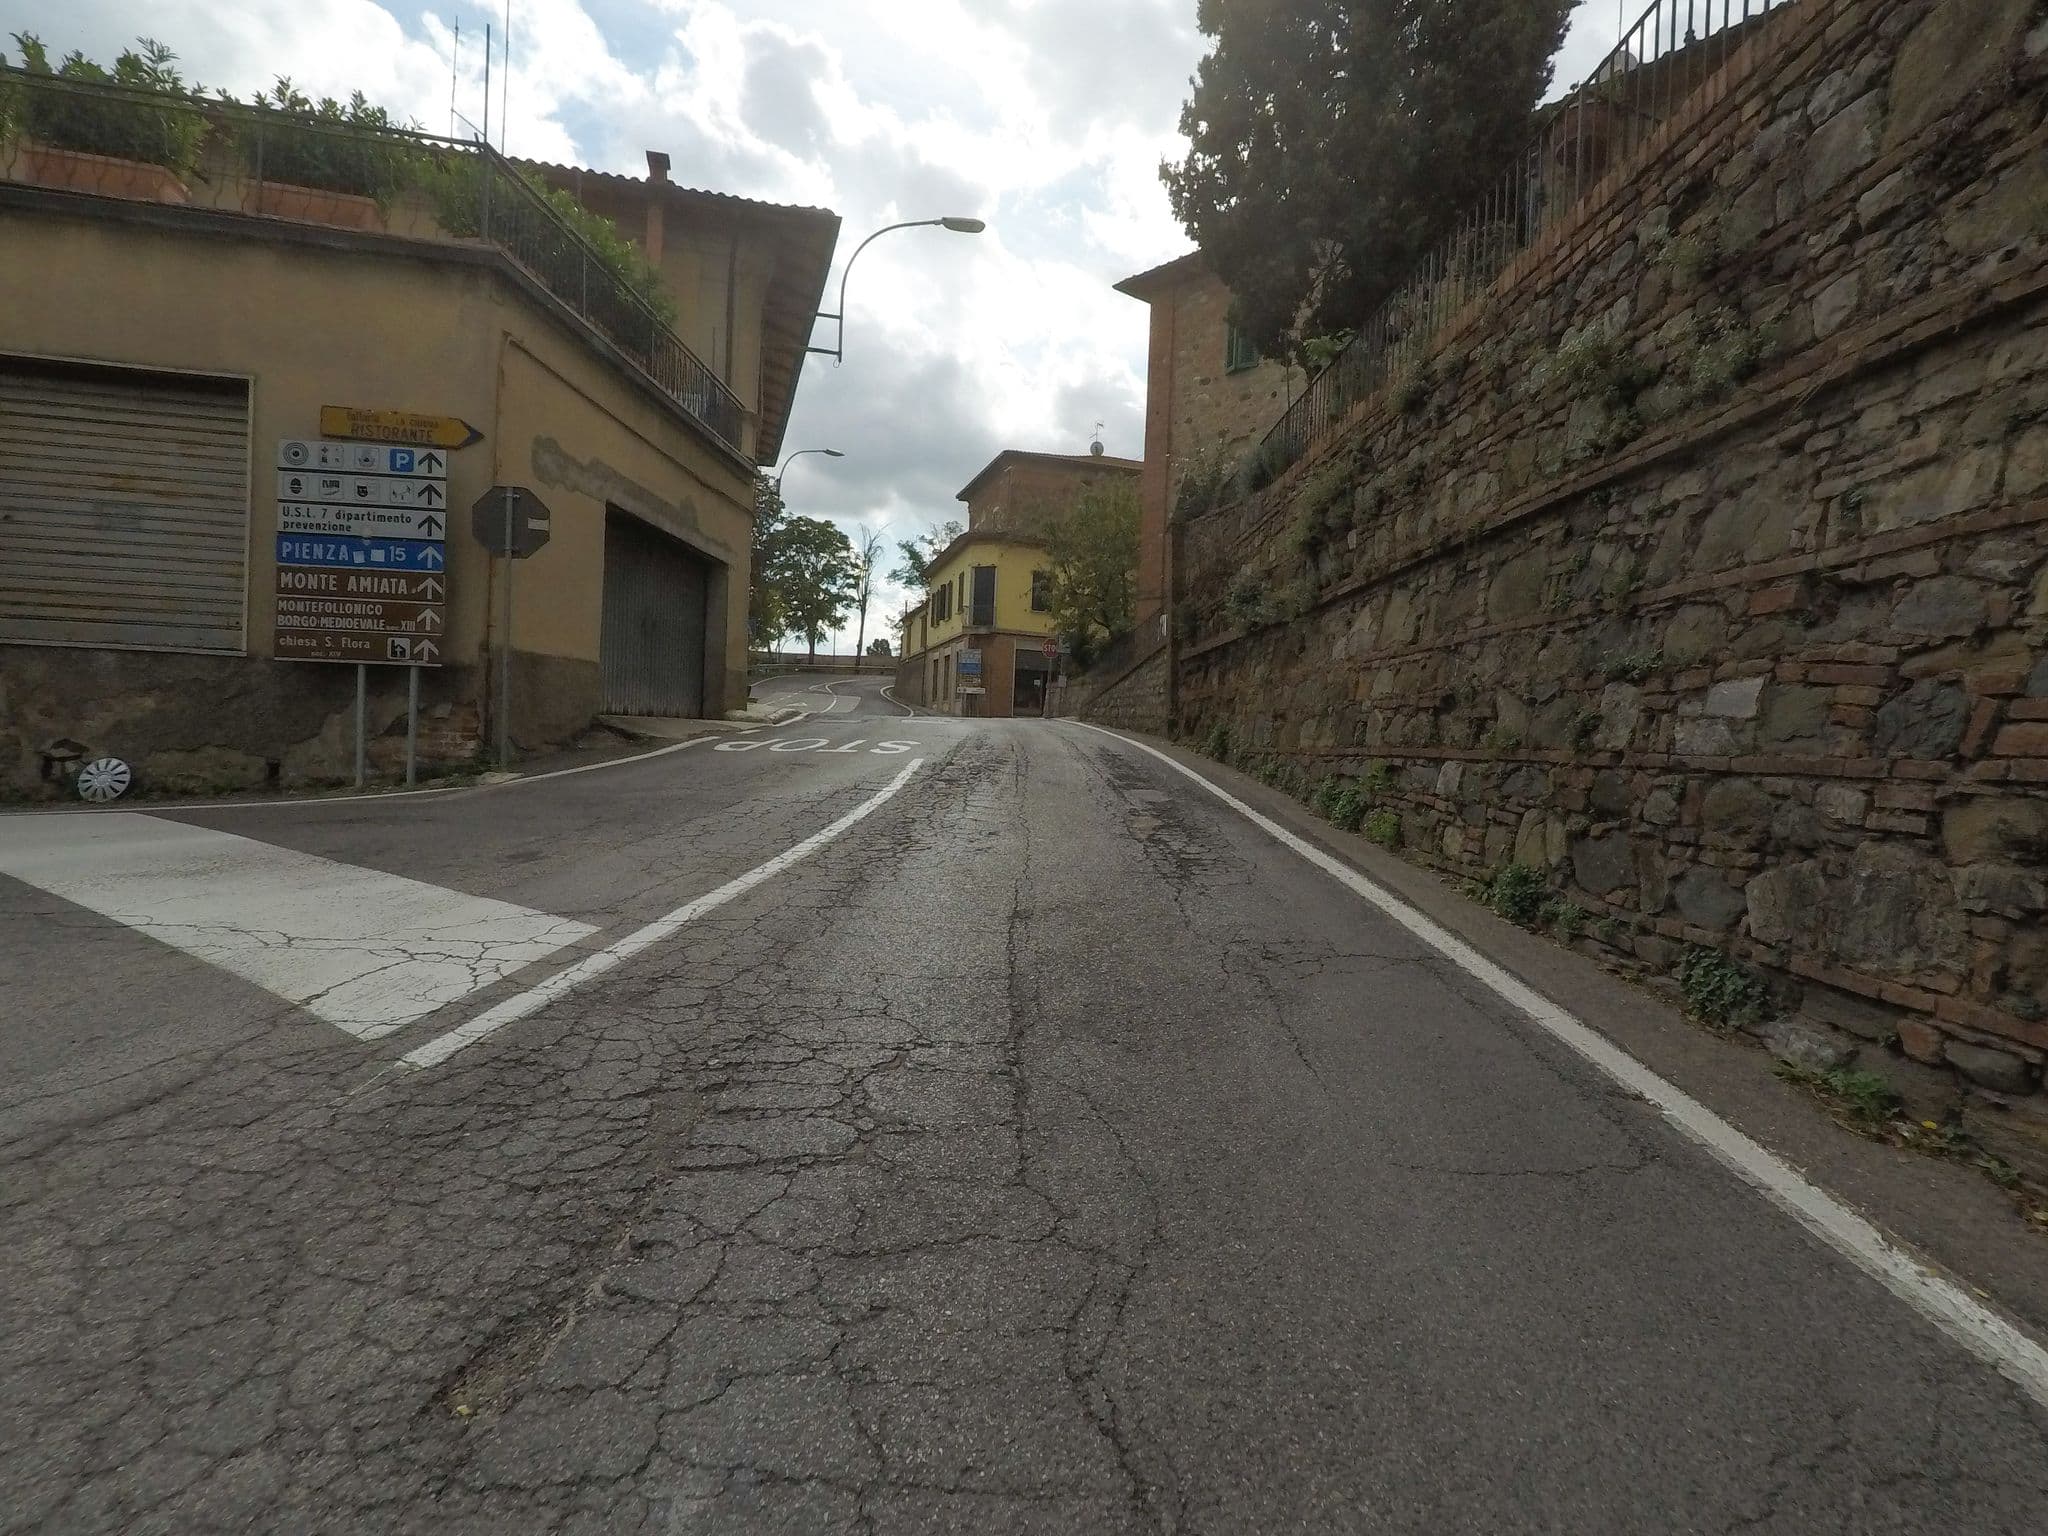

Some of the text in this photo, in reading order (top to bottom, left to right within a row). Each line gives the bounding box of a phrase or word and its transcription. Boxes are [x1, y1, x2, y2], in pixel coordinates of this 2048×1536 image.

[350, 423, 433, 442] RISTORANTE
[282, 506, 412, 524] U.S.L. 7 dipartimento
[283, 519, 352, 532] prevenzione
[282, 541, 407, 562] PIENZA 15
[280, 572, 408, 595] MONTE AMIATA
[278, 600, 383, 615] MONTEFOLLONICO
[277, 614, 317, 627] BORGO
[319, 616, 386, 631] MEDIOEVALE
[400, 620, 416, 632] XIII
[279, 636, 370, 649] chiesa S. Flora
[713, 738, 922, 754] STOP
